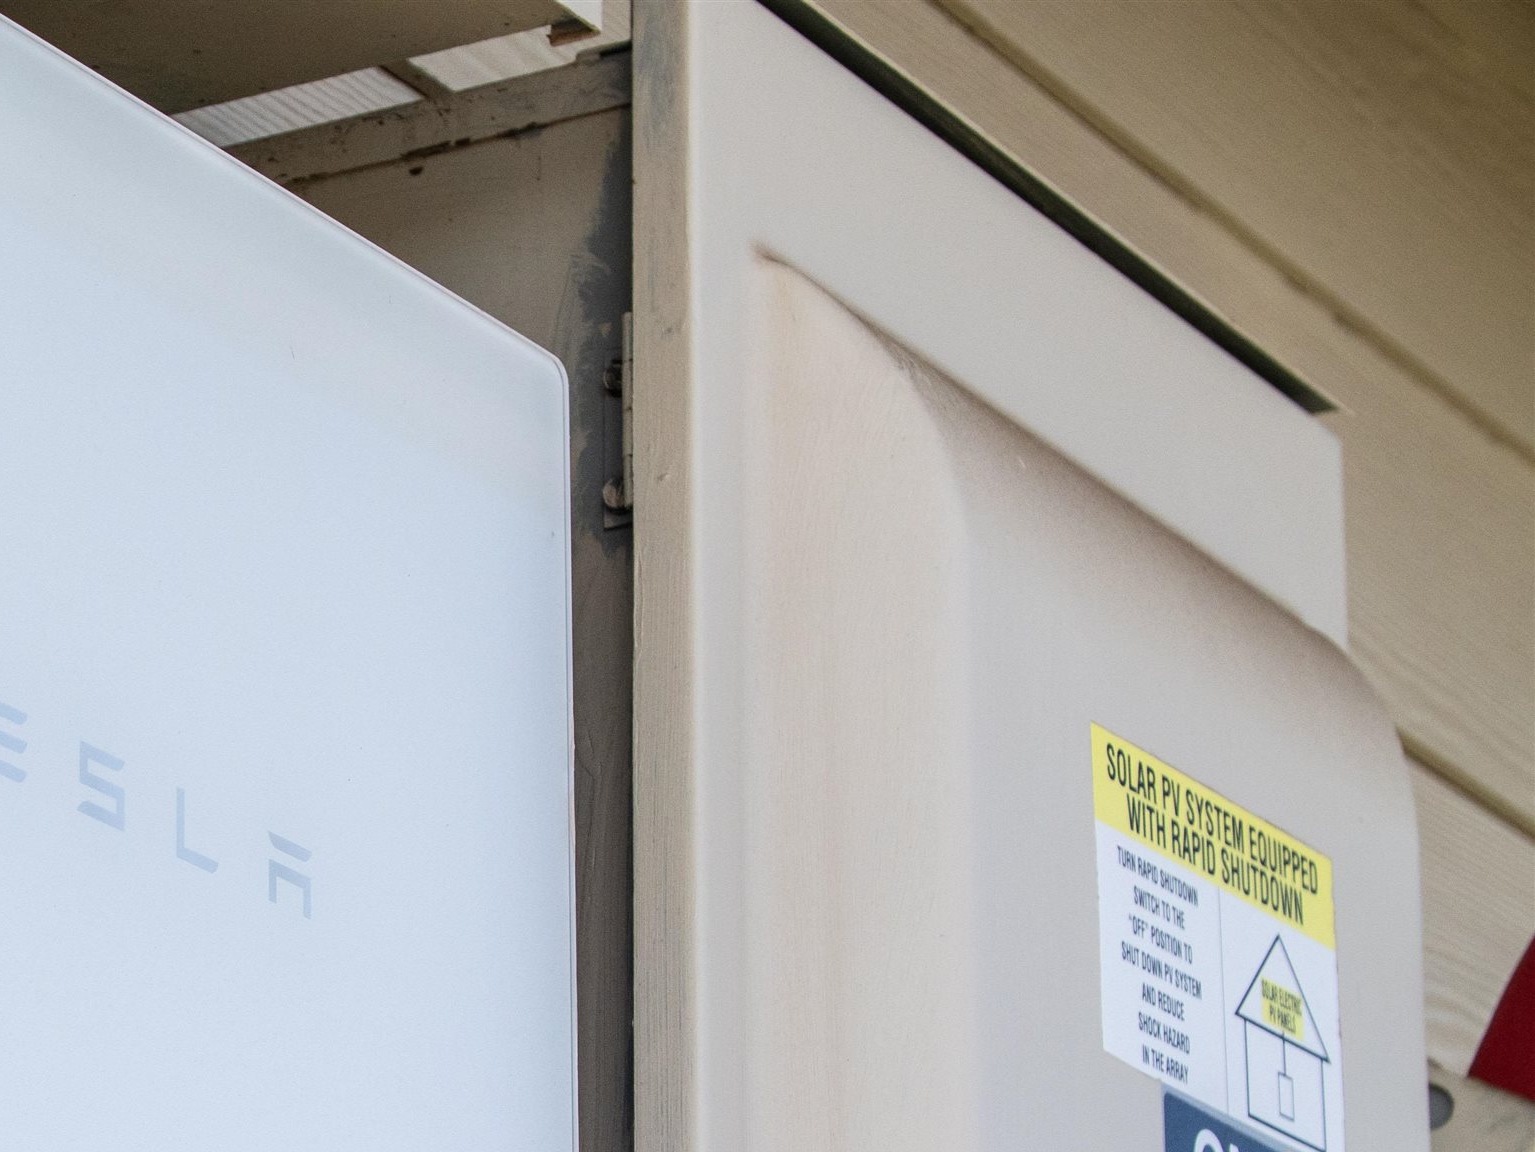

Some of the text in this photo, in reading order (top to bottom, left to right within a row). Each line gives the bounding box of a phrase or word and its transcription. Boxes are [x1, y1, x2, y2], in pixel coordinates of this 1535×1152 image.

[1106, 743, 1318, 895] SOLAR PV SYSTEM EQUIPPED
[1117, 845, 1198, 906] TURN RAPID SHUTDOWN
[1127, 793, 1303, 925] WITH RAPID SHUTDOWN
[1133, 885, 1185, 930] SWITCH TO THE
[1151, 925, 1182, 959] POSITION
[1184, 943, 1193, 964] TO
[1121, 940, 1202, 1000] SHUT DOWN PV SYSTEM
[1142, 982, 1185, 1021] AND REDUCE
[1277, 1008, 1296, 1034] PANELS
[1279, 987, 1302, 1016] ELECTRIC
[1138, 1011, 1190, 1055] SHOCK HAZARD
[1142, 1044, 1189, 1084] IN THE ARRAY
